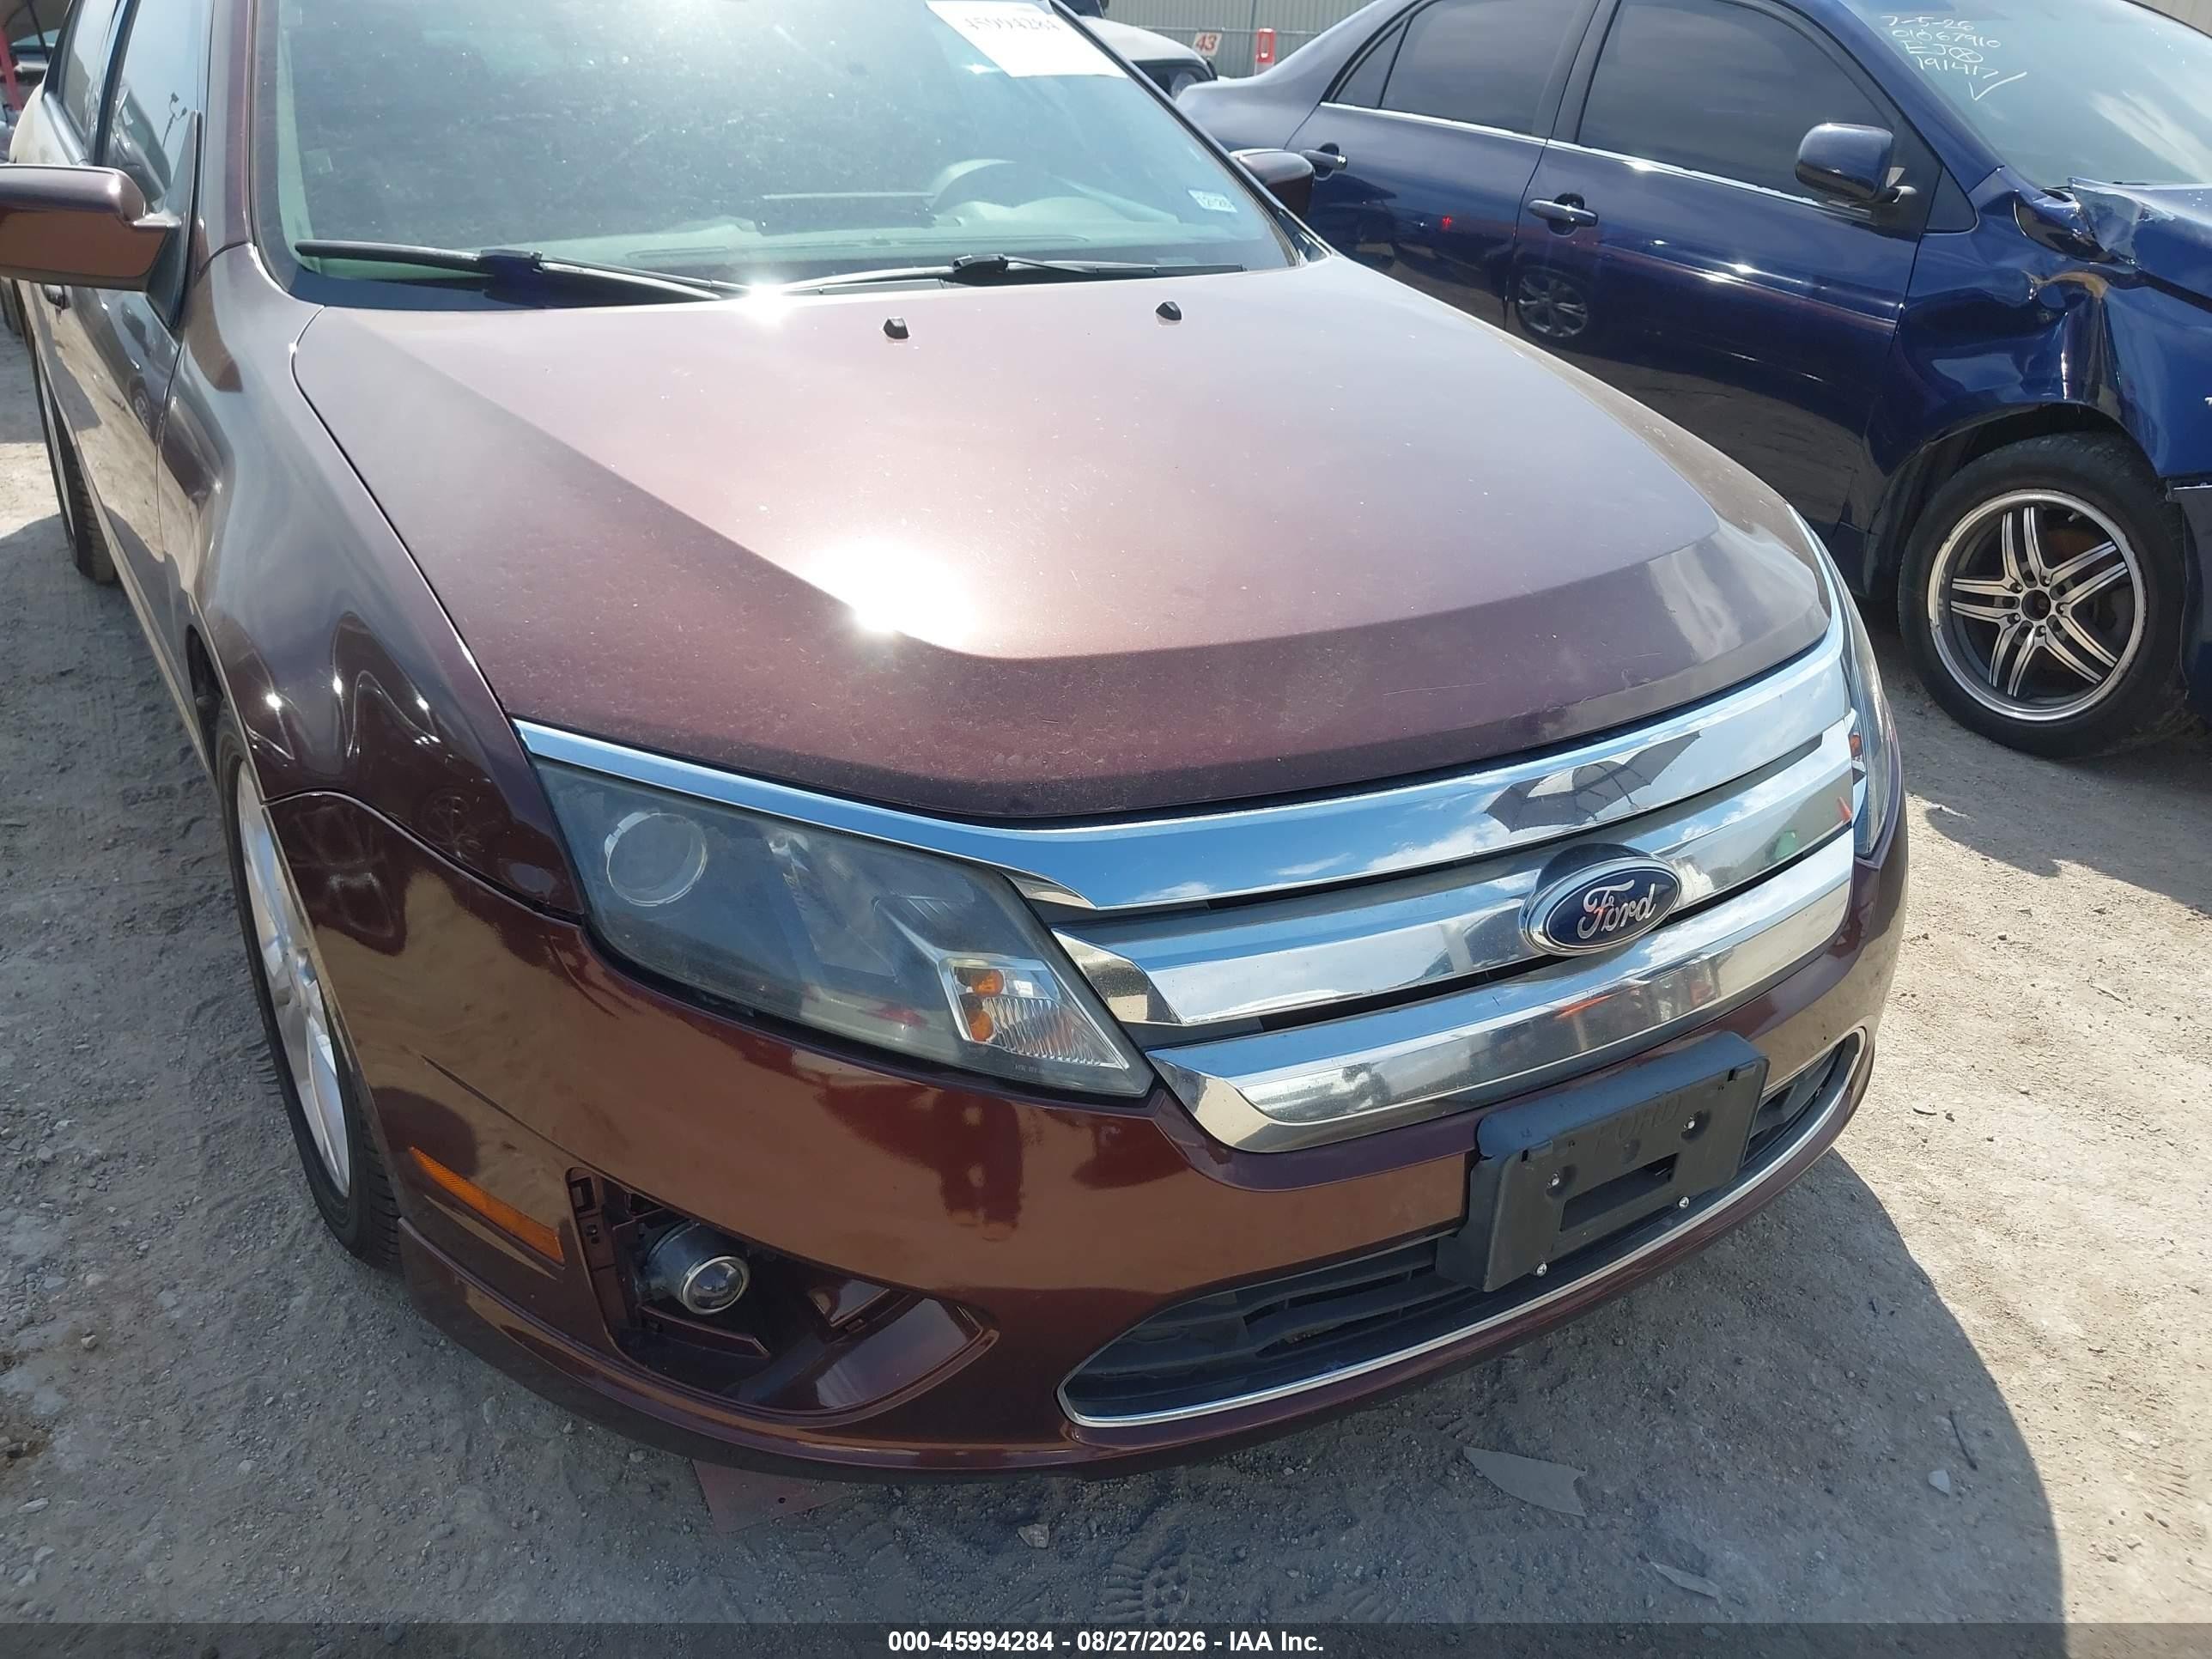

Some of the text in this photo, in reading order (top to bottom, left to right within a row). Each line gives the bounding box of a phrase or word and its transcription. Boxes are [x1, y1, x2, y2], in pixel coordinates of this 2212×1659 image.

[1194, 33, 1218, 52] 43
[1577, 878, 1656, 939] Ford
[1595, 1094, 1682, 1154] FORD
